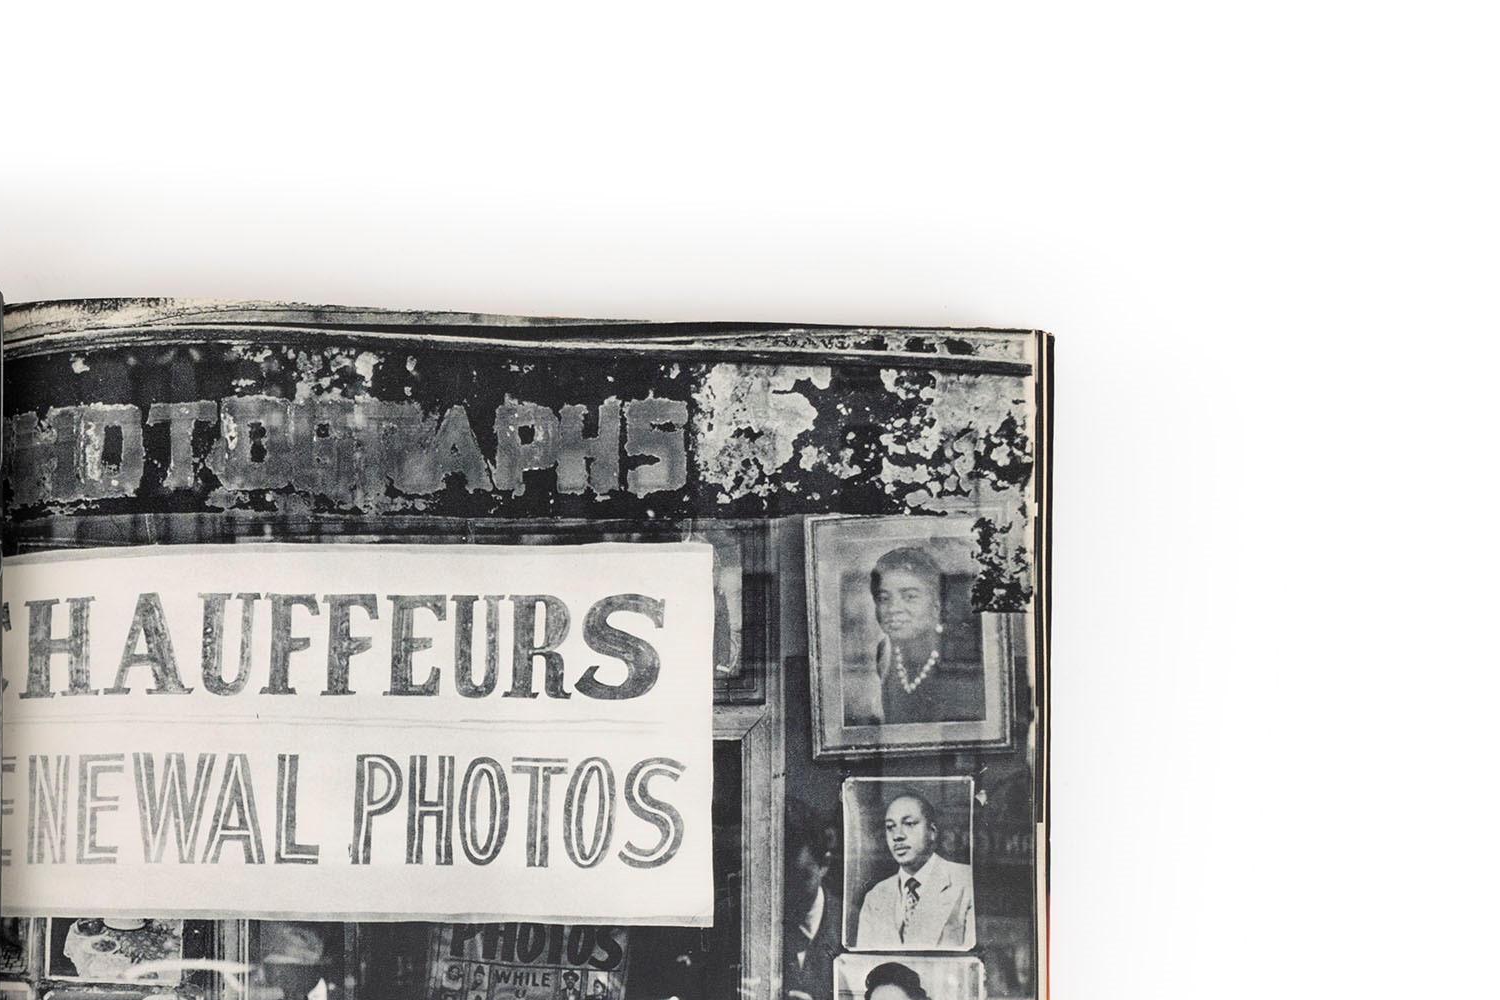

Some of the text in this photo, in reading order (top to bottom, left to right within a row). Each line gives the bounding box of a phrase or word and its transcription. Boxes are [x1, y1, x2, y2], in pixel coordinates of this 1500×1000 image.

[2, 591, 665, 700] HAUFFEURS
[350, 754, 683, 868] PHOTOS
[493, 968, 551, 987] WHILE
